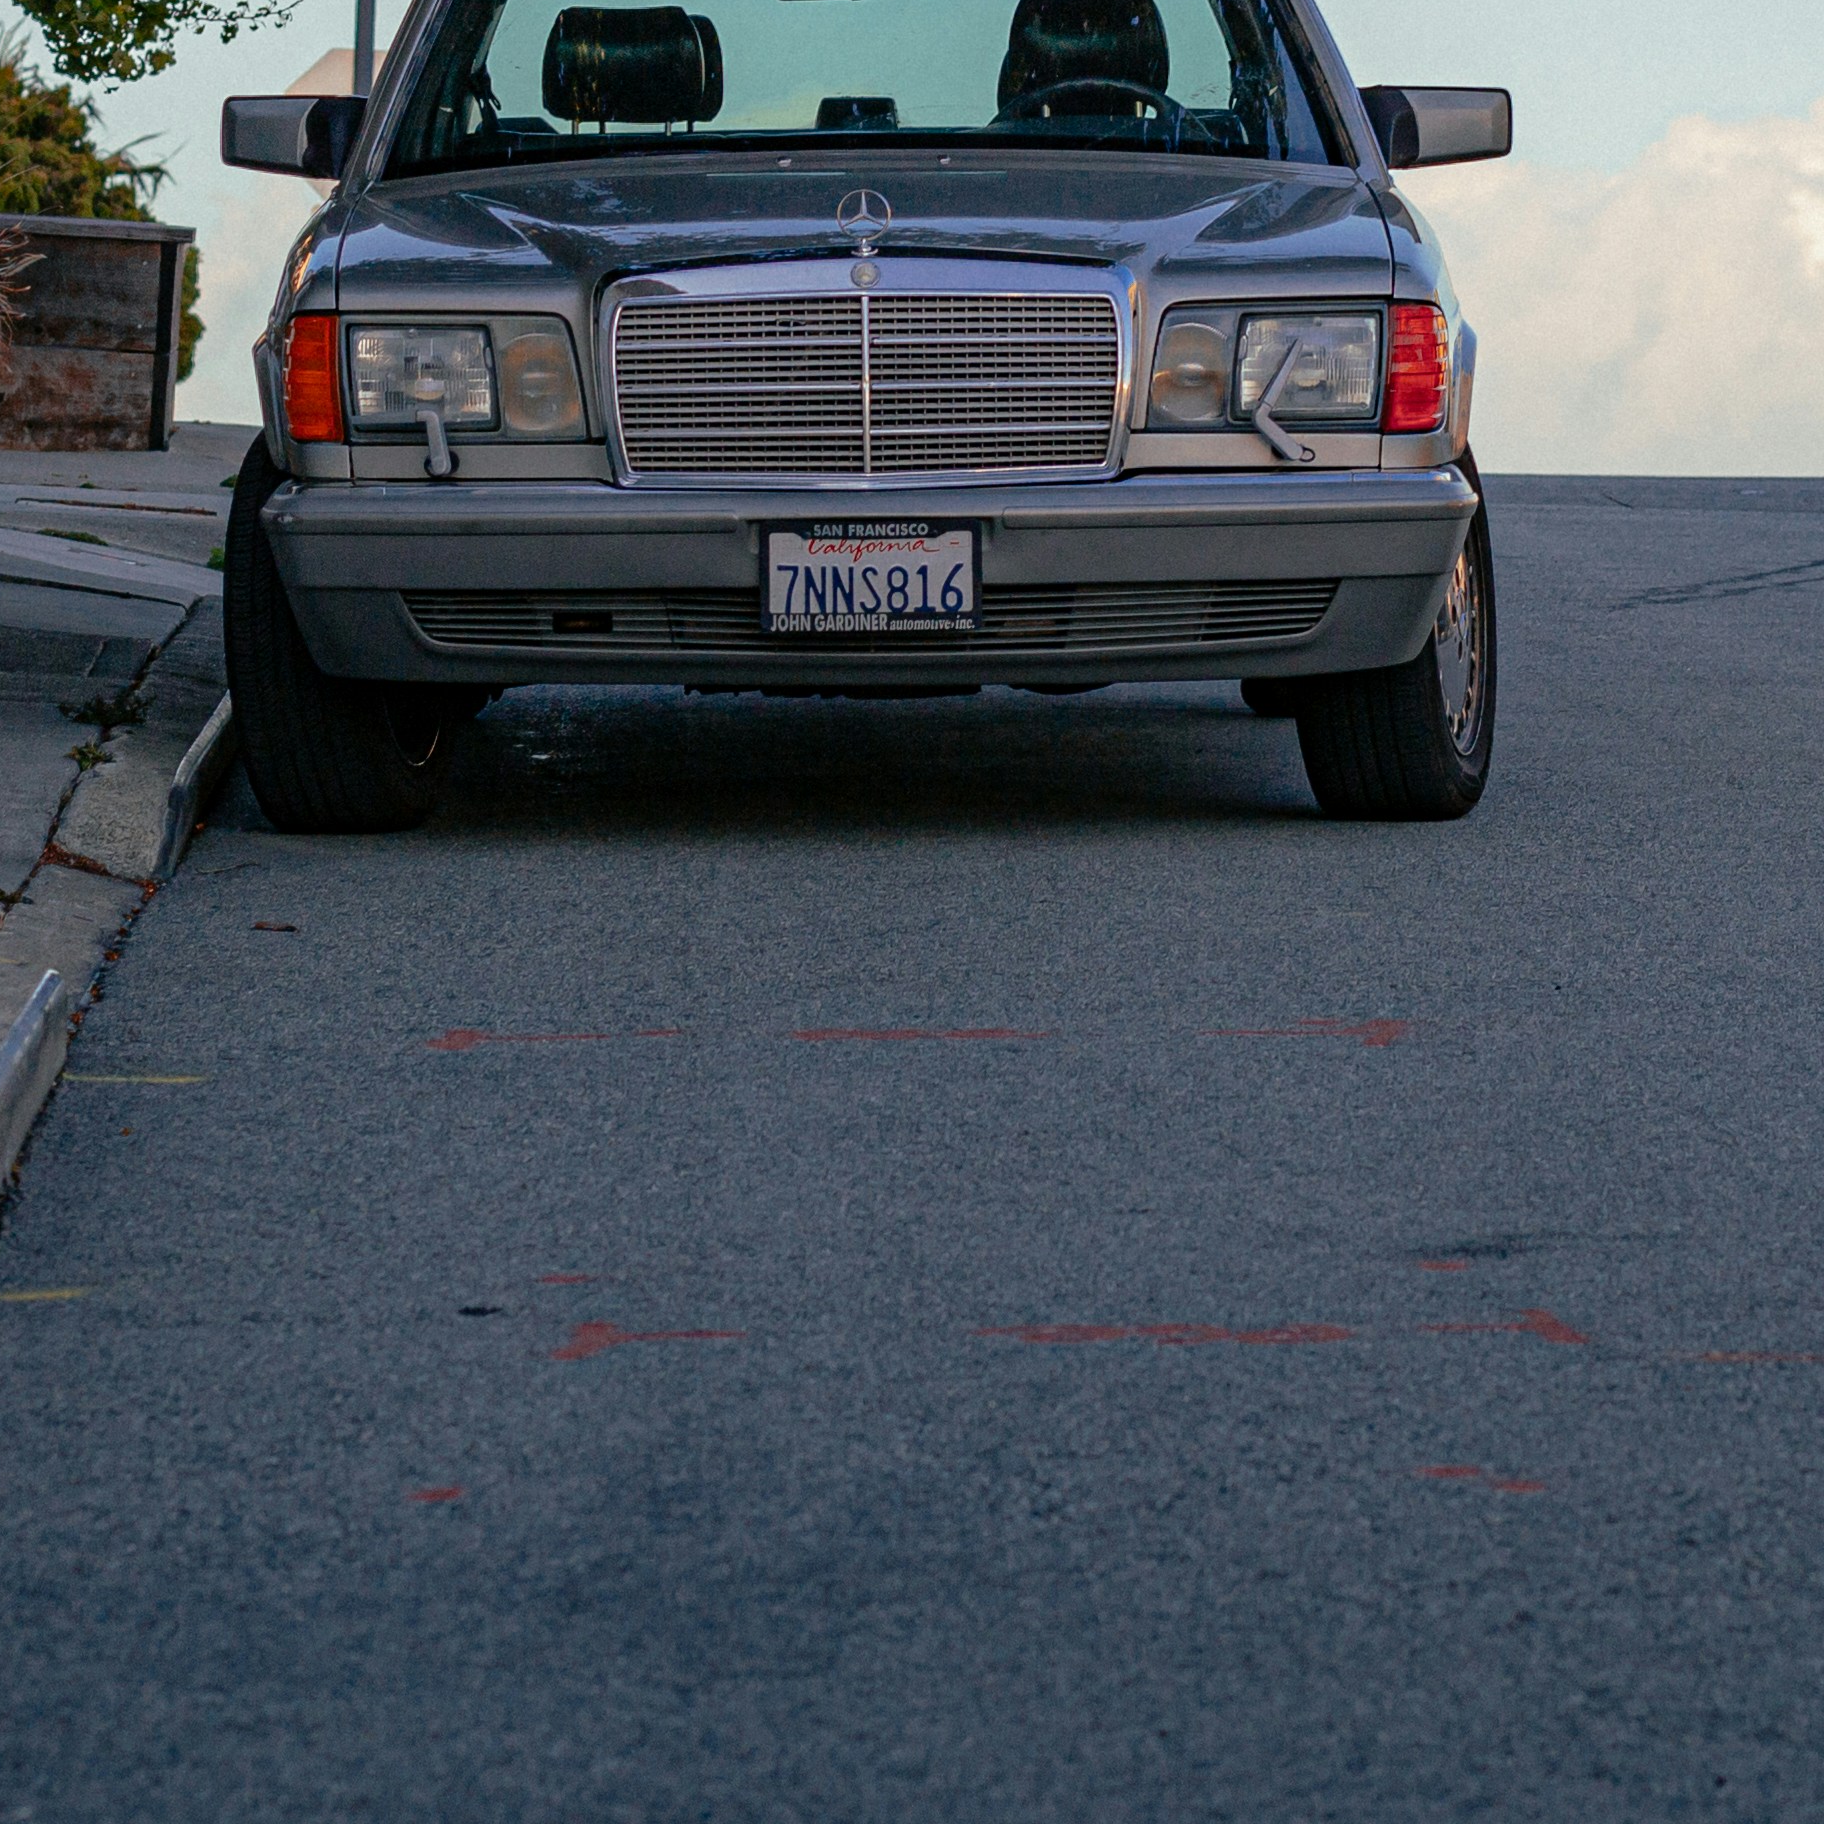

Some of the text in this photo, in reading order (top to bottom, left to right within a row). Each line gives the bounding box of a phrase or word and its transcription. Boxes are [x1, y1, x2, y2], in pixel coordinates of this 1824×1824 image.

[813, 523, 929, 537] SAN FRANCISCO
[808, 536, 941, 563] California
[776, 562, 964, 614] 7NNS816
[770, 614, 811, 632] JOHN
[814, 613, 888, 632] GARDINER
